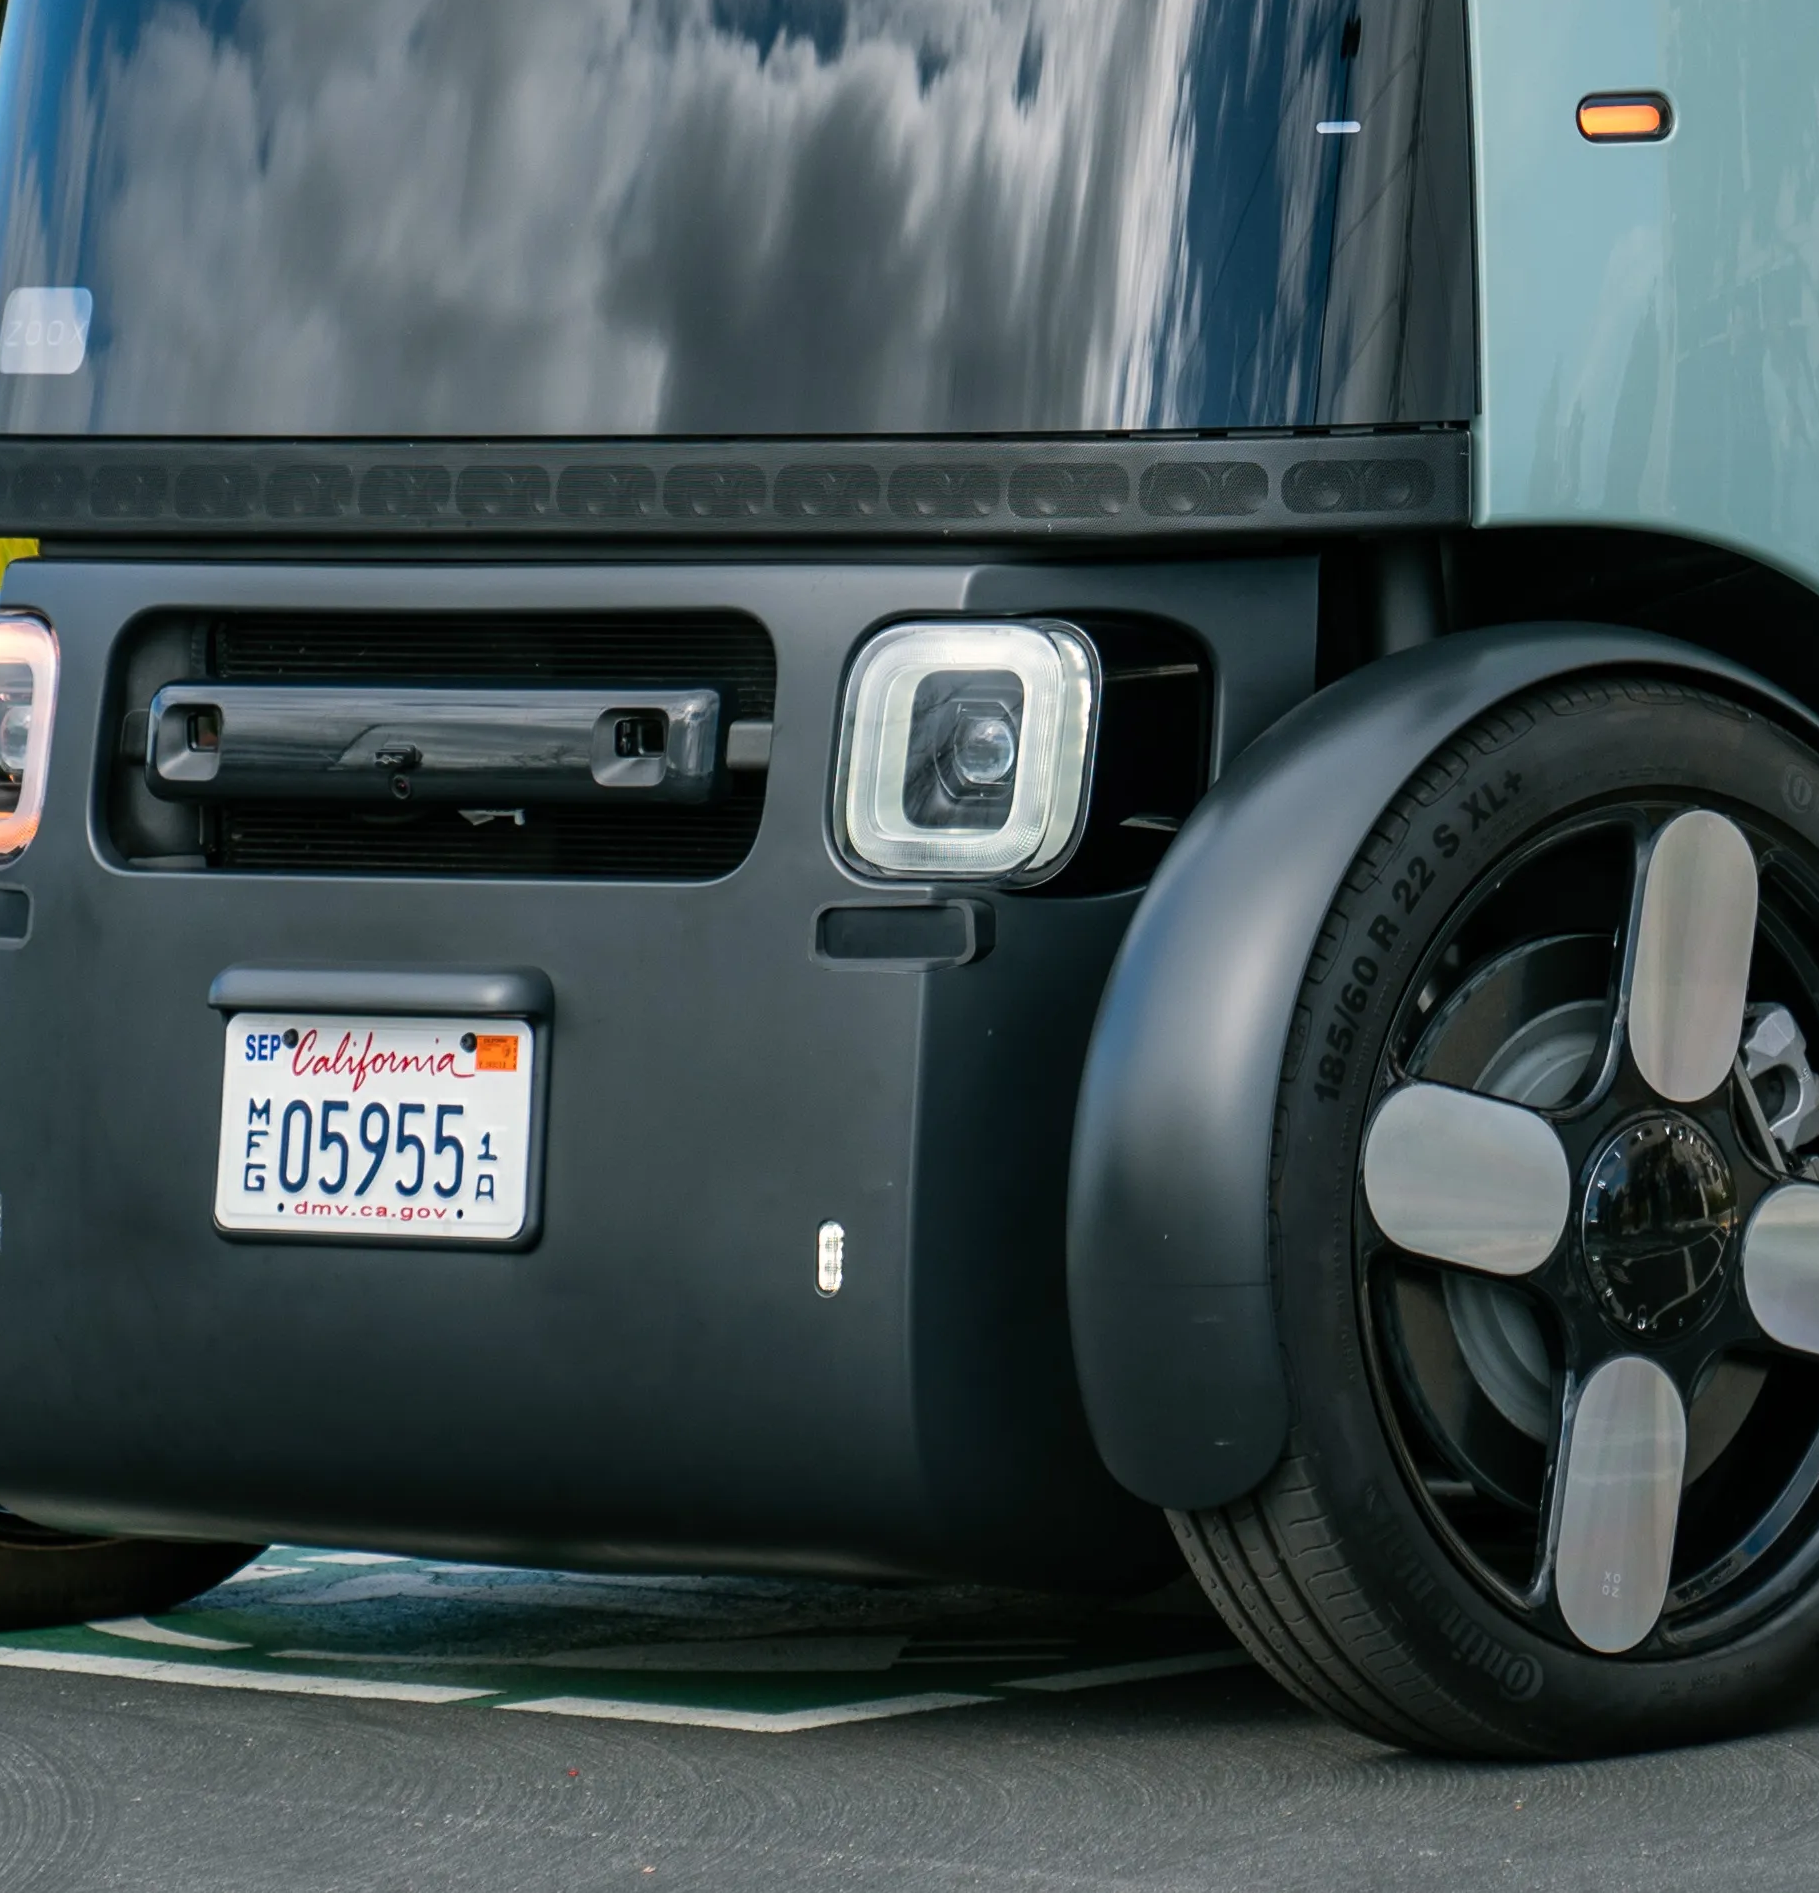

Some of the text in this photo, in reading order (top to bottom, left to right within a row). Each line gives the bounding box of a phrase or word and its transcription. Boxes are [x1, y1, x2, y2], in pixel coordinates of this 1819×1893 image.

[1313, 955, 1380, 1105] 185/60
[1367, 913, 1401, 953] R
[1391, 855, 1437, 907] 22
[1432, 823, 1461, 859] S
[245, 1033, 281, 1061] SEP
[291, 1028, 475, 1092] California
[280, 1099, 464, 1199] 05955
[293, 1200, 448, 1221] dmv.ca.gov
